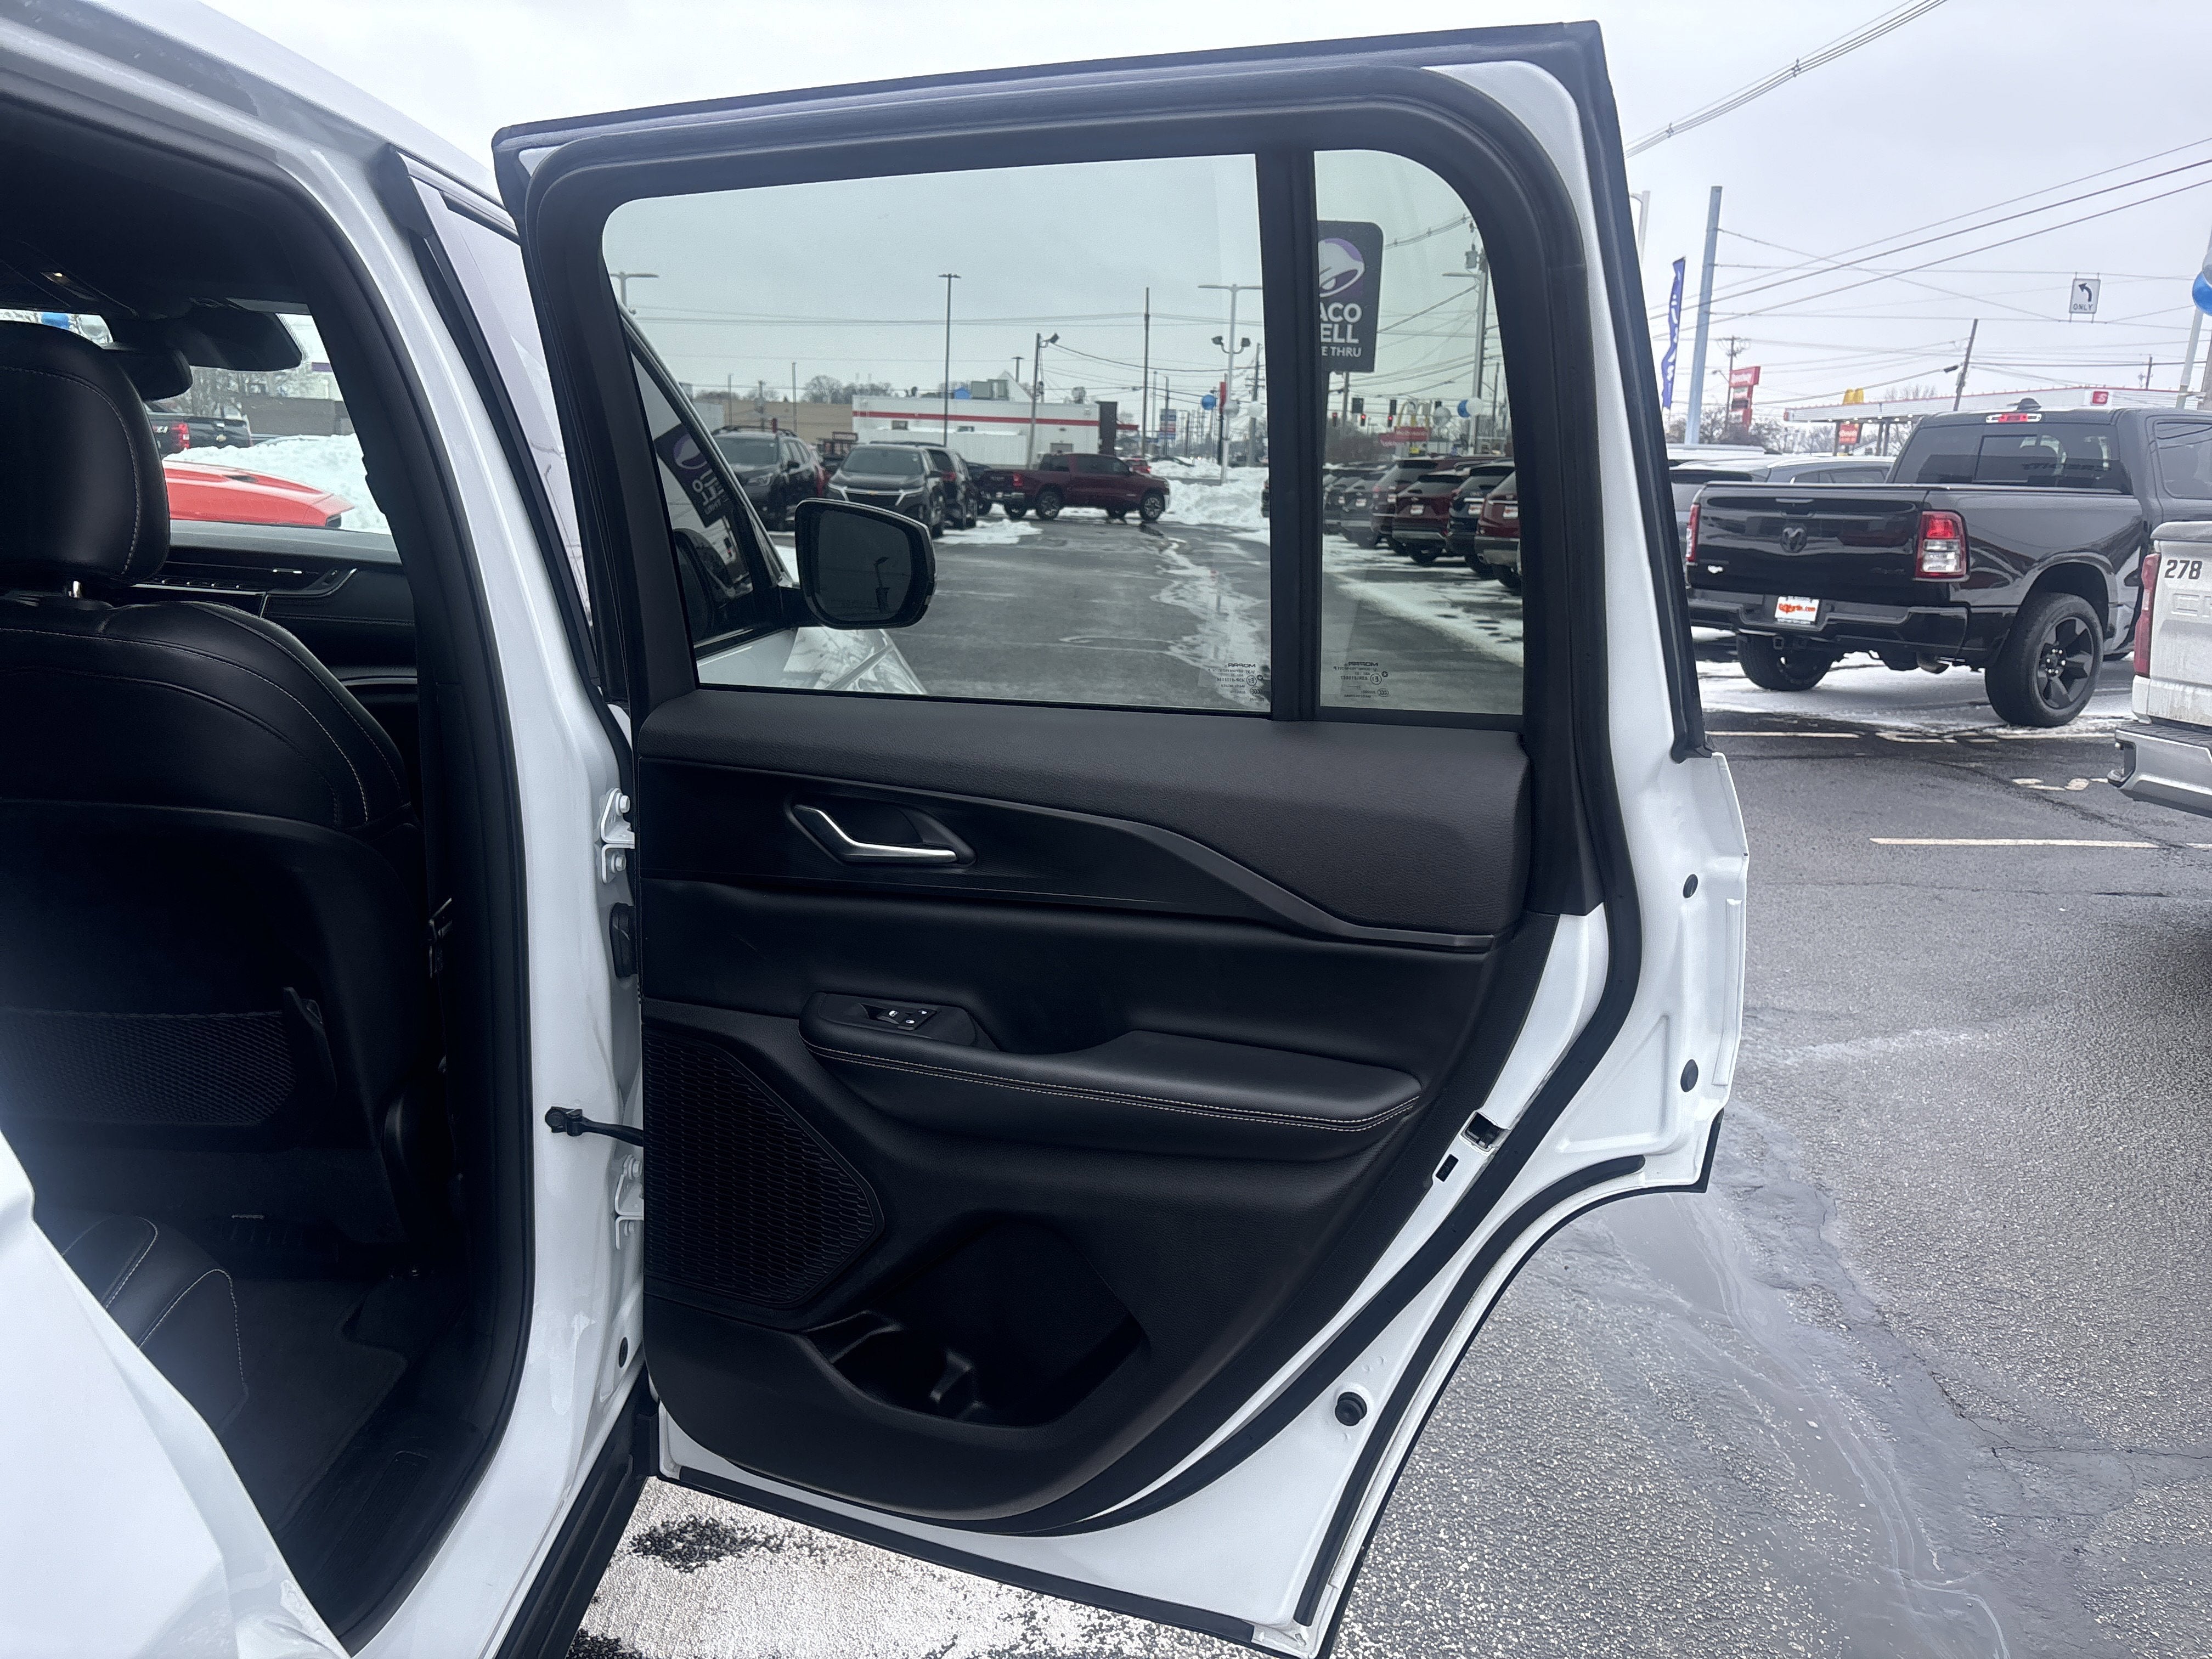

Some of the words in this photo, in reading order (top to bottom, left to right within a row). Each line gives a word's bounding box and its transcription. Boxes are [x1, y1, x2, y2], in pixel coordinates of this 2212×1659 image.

[1320, 302, 1362, 323] ACO
[1321, 323, 1359, 343] ELL
[1330, 346, 1362, 358] THRU
[2164, 559, 2203, 579] 278
